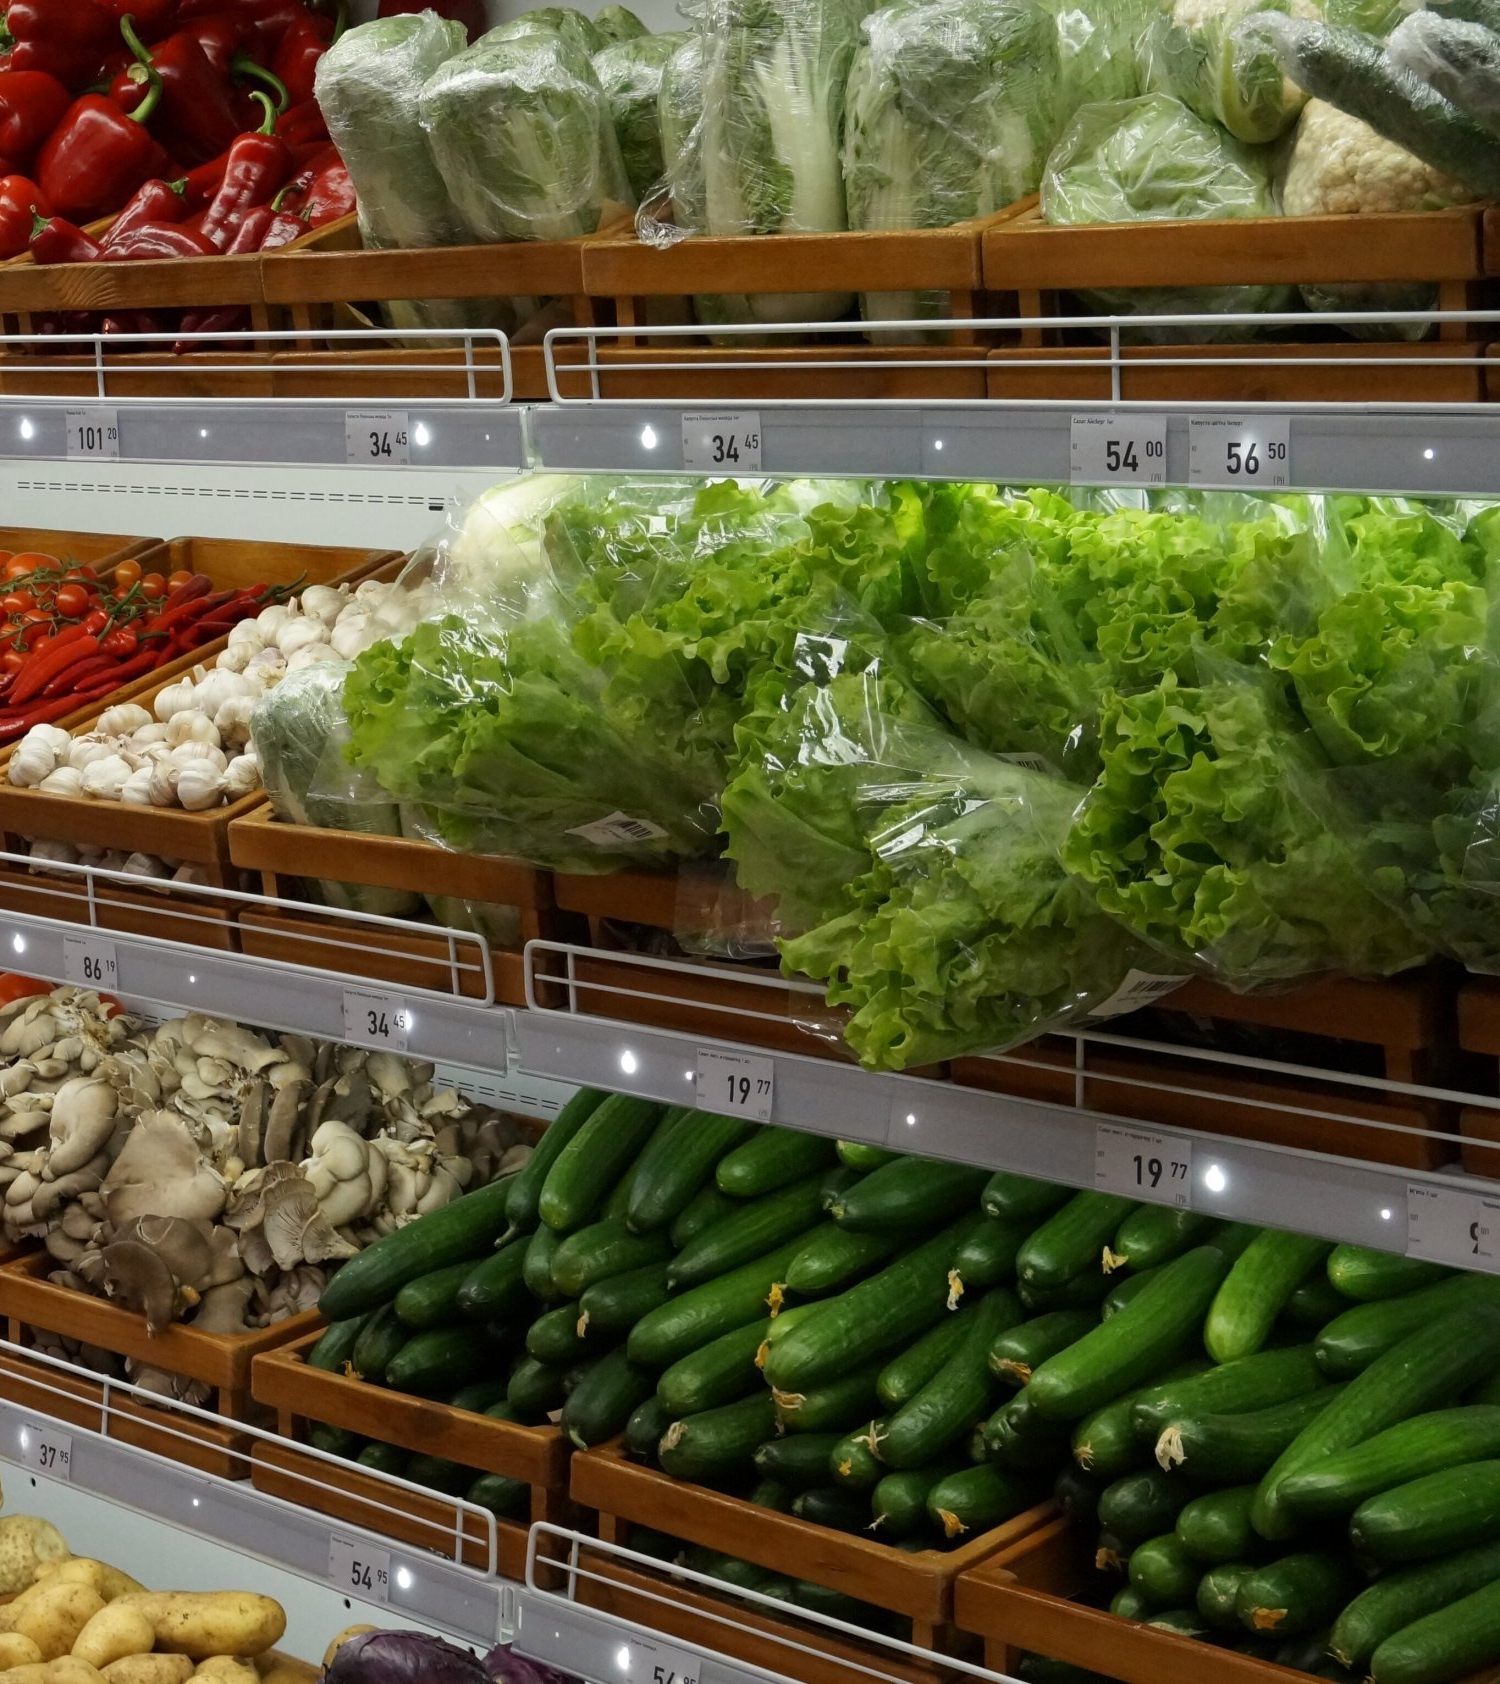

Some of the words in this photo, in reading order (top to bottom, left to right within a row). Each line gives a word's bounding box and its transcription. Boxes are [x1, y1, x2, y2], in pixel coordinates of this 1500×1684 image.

[78, 427, 102, 450] 101
[107, 428, 117, 440] 20
[370, 432, 392, 457] 34
[396, 432, 407, 445] 45
[712, 435, 739, 463] 34
[744, 434, 759, 449] 45
[1106, 441, 1139, 472] 54
[1146, 441, 1163, 457] 00
[1227, 442, 1259, 475] 56
[1268, 442, 1286, 460] 50
[84, 956, 102, 980] 86
[106, 959, 115, 972] 19
[367, 1010, 389, 1037] 34
[393, 1014, 405, 1028] 45
[727, 1075, 750, 1104] 19
[757, 1079, 771, 1095] 77
[1133, 1155, 1163, 1188] 19
[1170, 1161, 1188, 1180] 77
[40, 1444, 56, 1468] 37
[59, 1450, 68, 1464] 95
[351, 1561, 372, 1590] 54
[377, 1569, 387, 1584] 95
